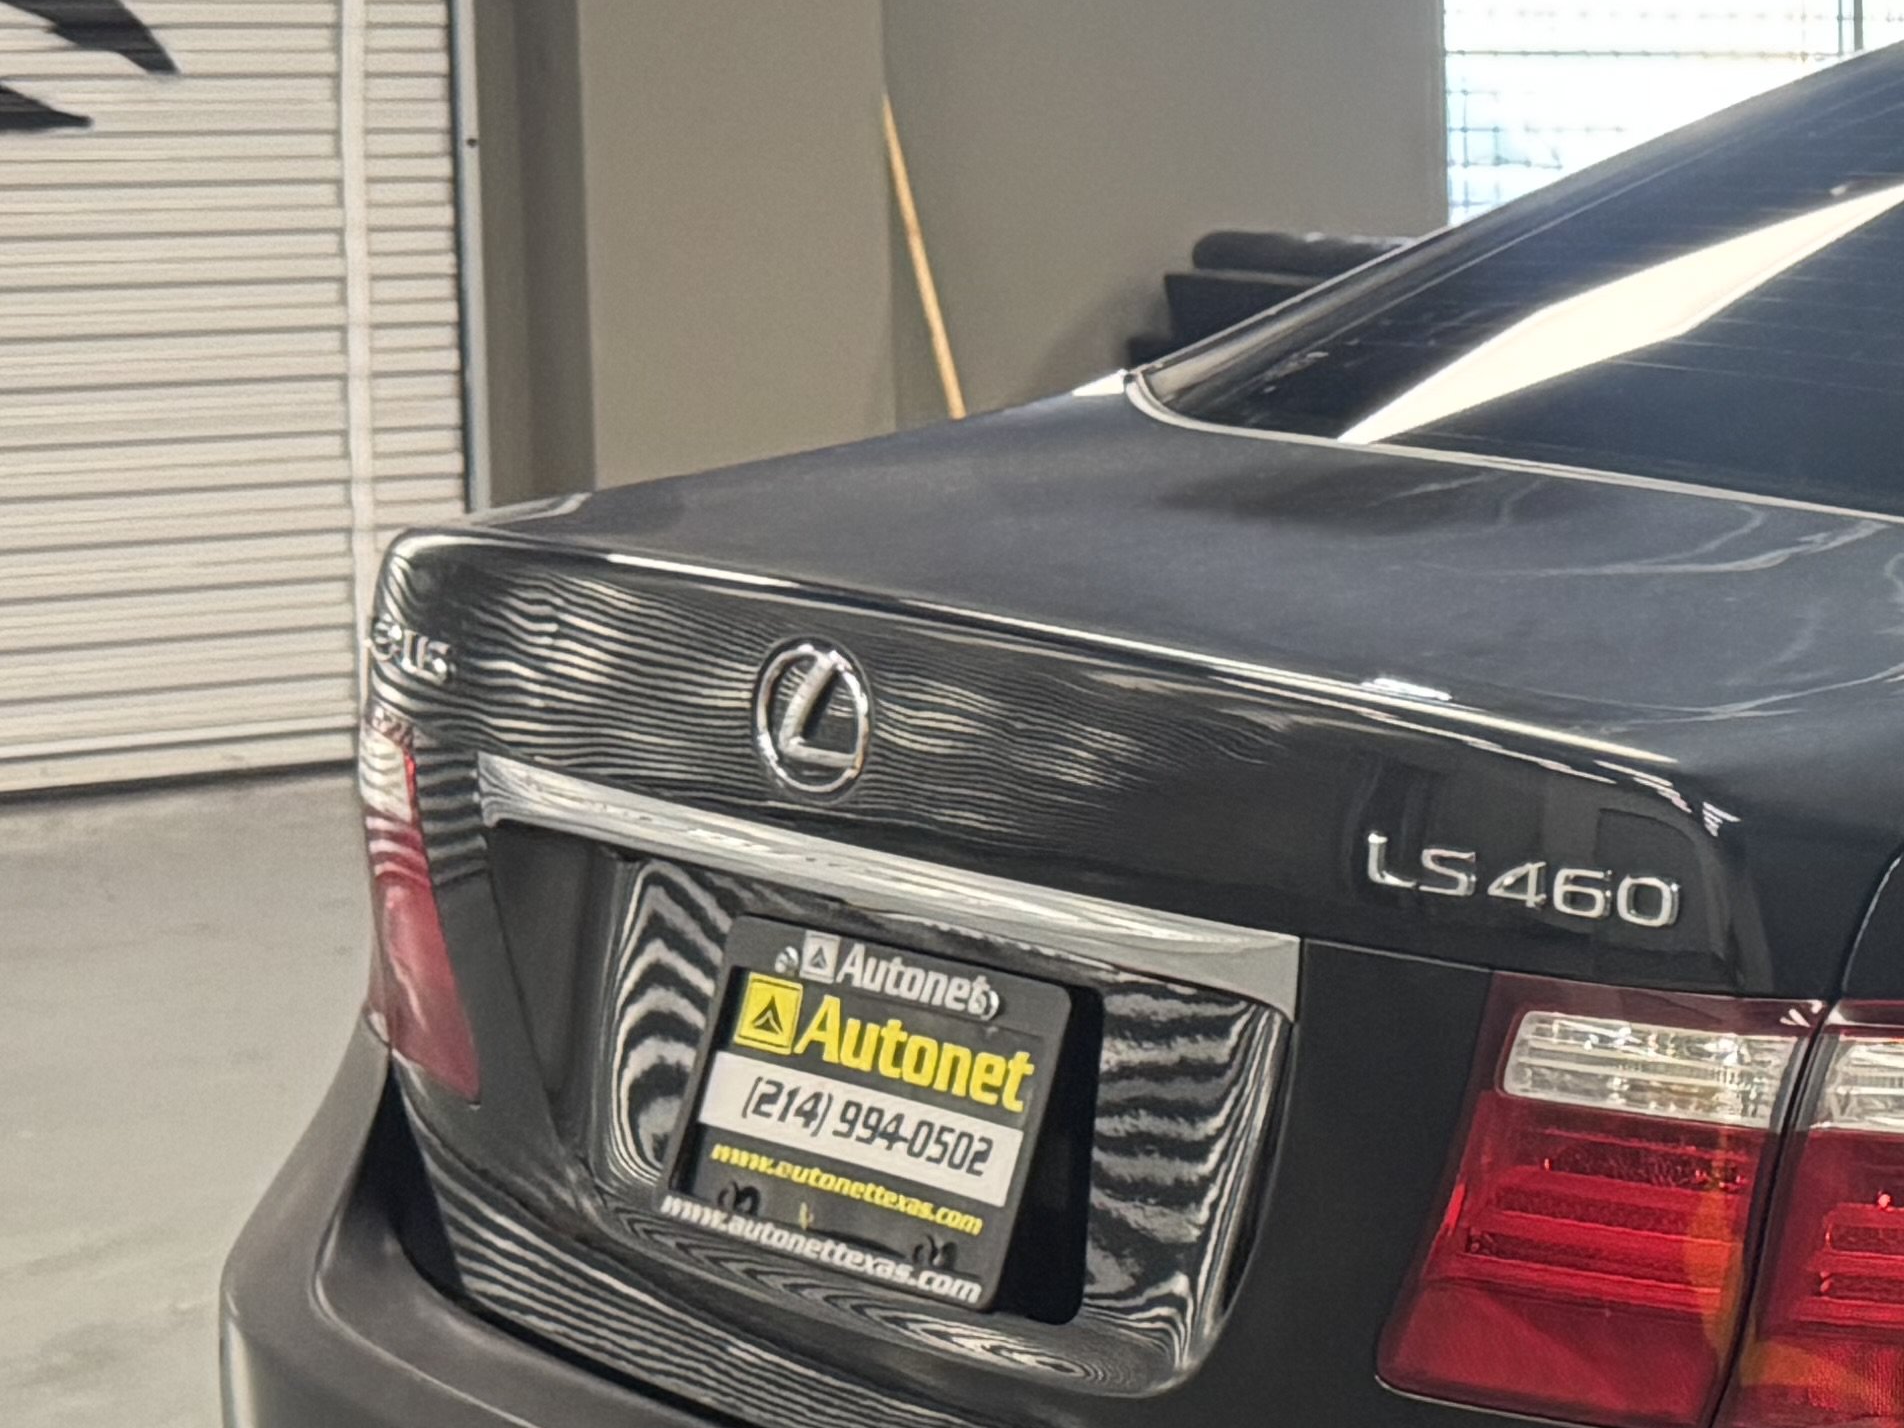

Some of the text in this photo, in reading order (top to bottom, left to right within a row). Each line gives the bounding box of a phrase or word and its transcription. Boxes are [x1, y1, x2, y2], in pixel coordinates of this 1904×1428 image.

[836, 943, 992, 1019] Autonet
[793, 994, 1034, 1113] Autonet
[742, 1077, 993, 1177] (214) 994-0502
[710, 1143, 983, 1236] www.autonettexas.com
[660, 1193, 981, 1304] www.autonettexas.com
